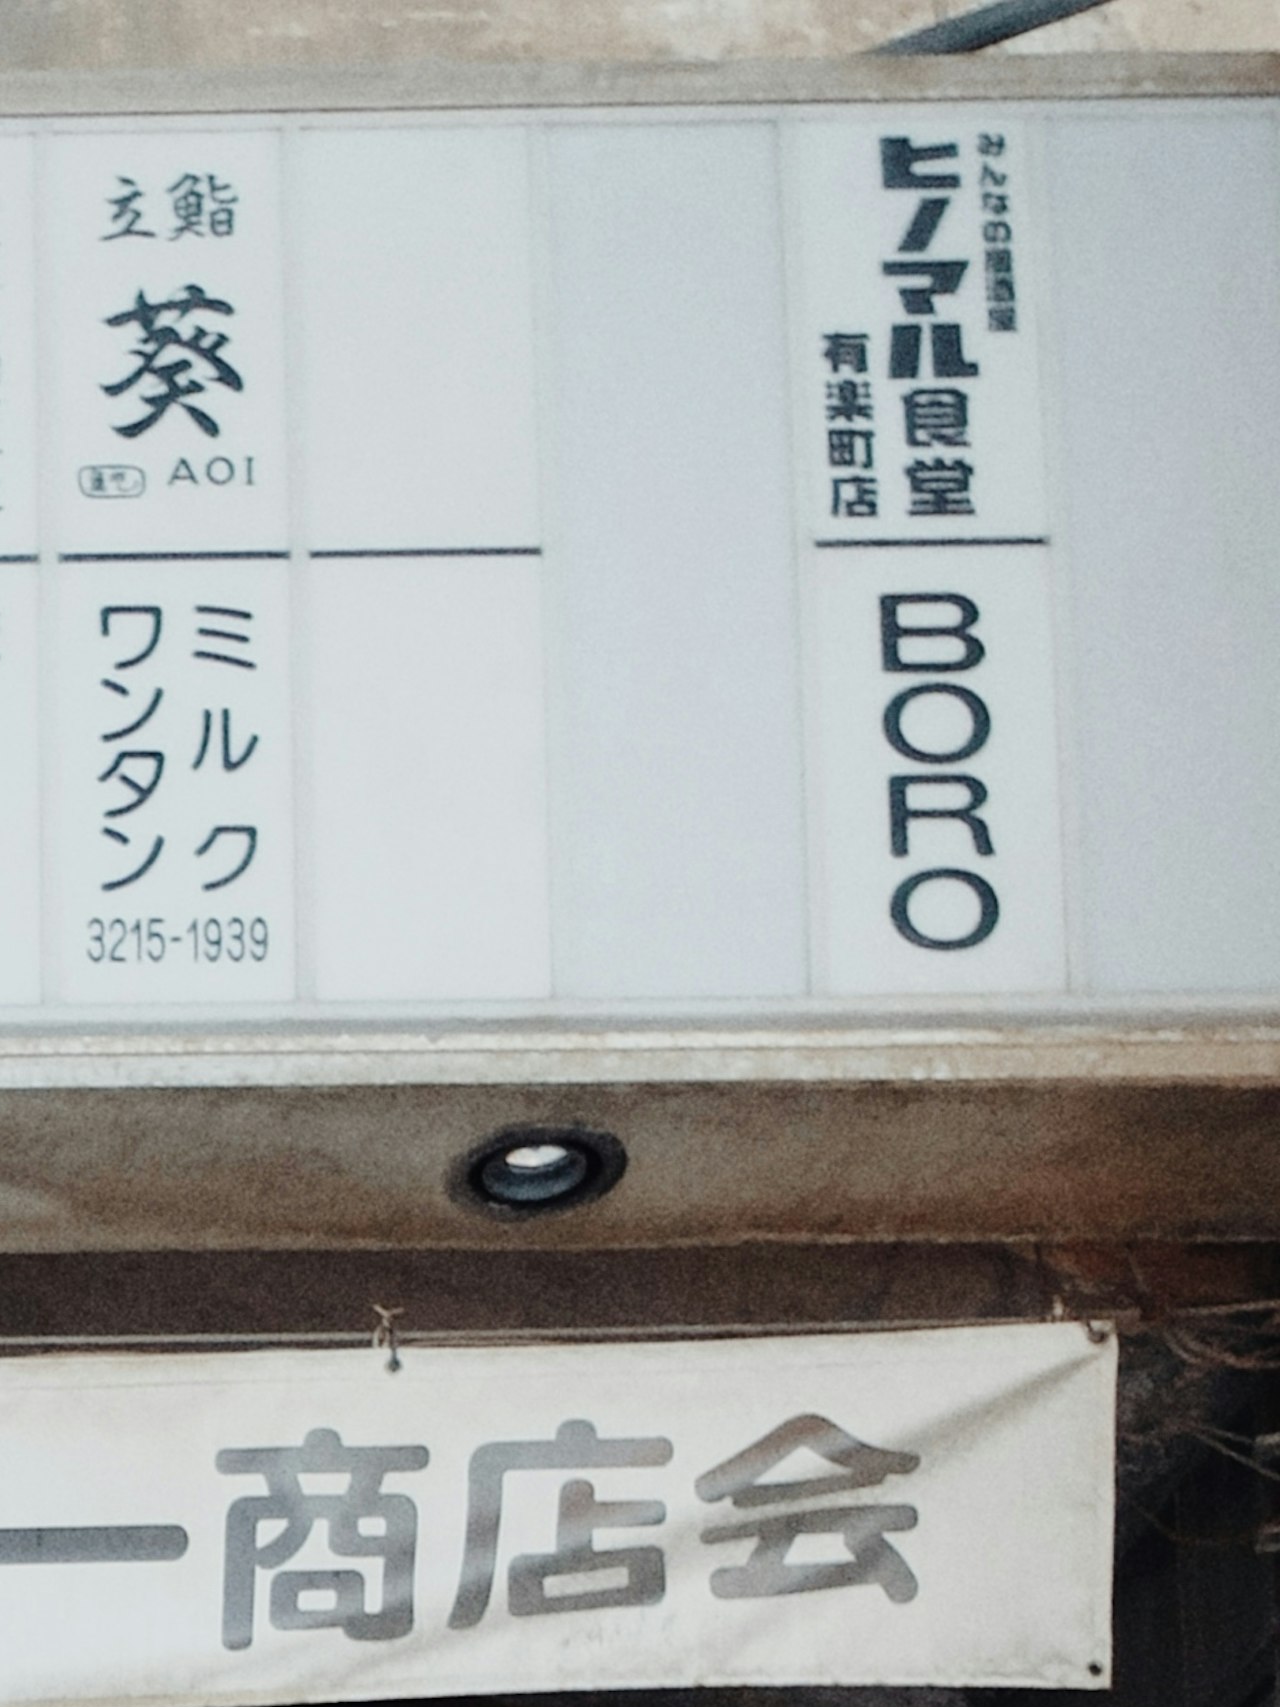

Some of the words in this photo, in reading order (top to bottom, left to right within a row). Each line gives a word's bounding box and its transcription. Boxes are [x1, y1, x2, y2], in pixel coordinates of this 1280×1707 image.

[100, 284, 244, 439] 葵
[821, 331, 879, 518] 有楽町店
[878, 134, 981, 517] ヒノマル食堂
[168, 456, 254, 486] AOI
[97, 605, 166, 892] ワンタン
[191, 605, 259, 892] ミルク
[878, 592, 1000, 952] BORO
[87, 916, 269, 963] 3215-1939
